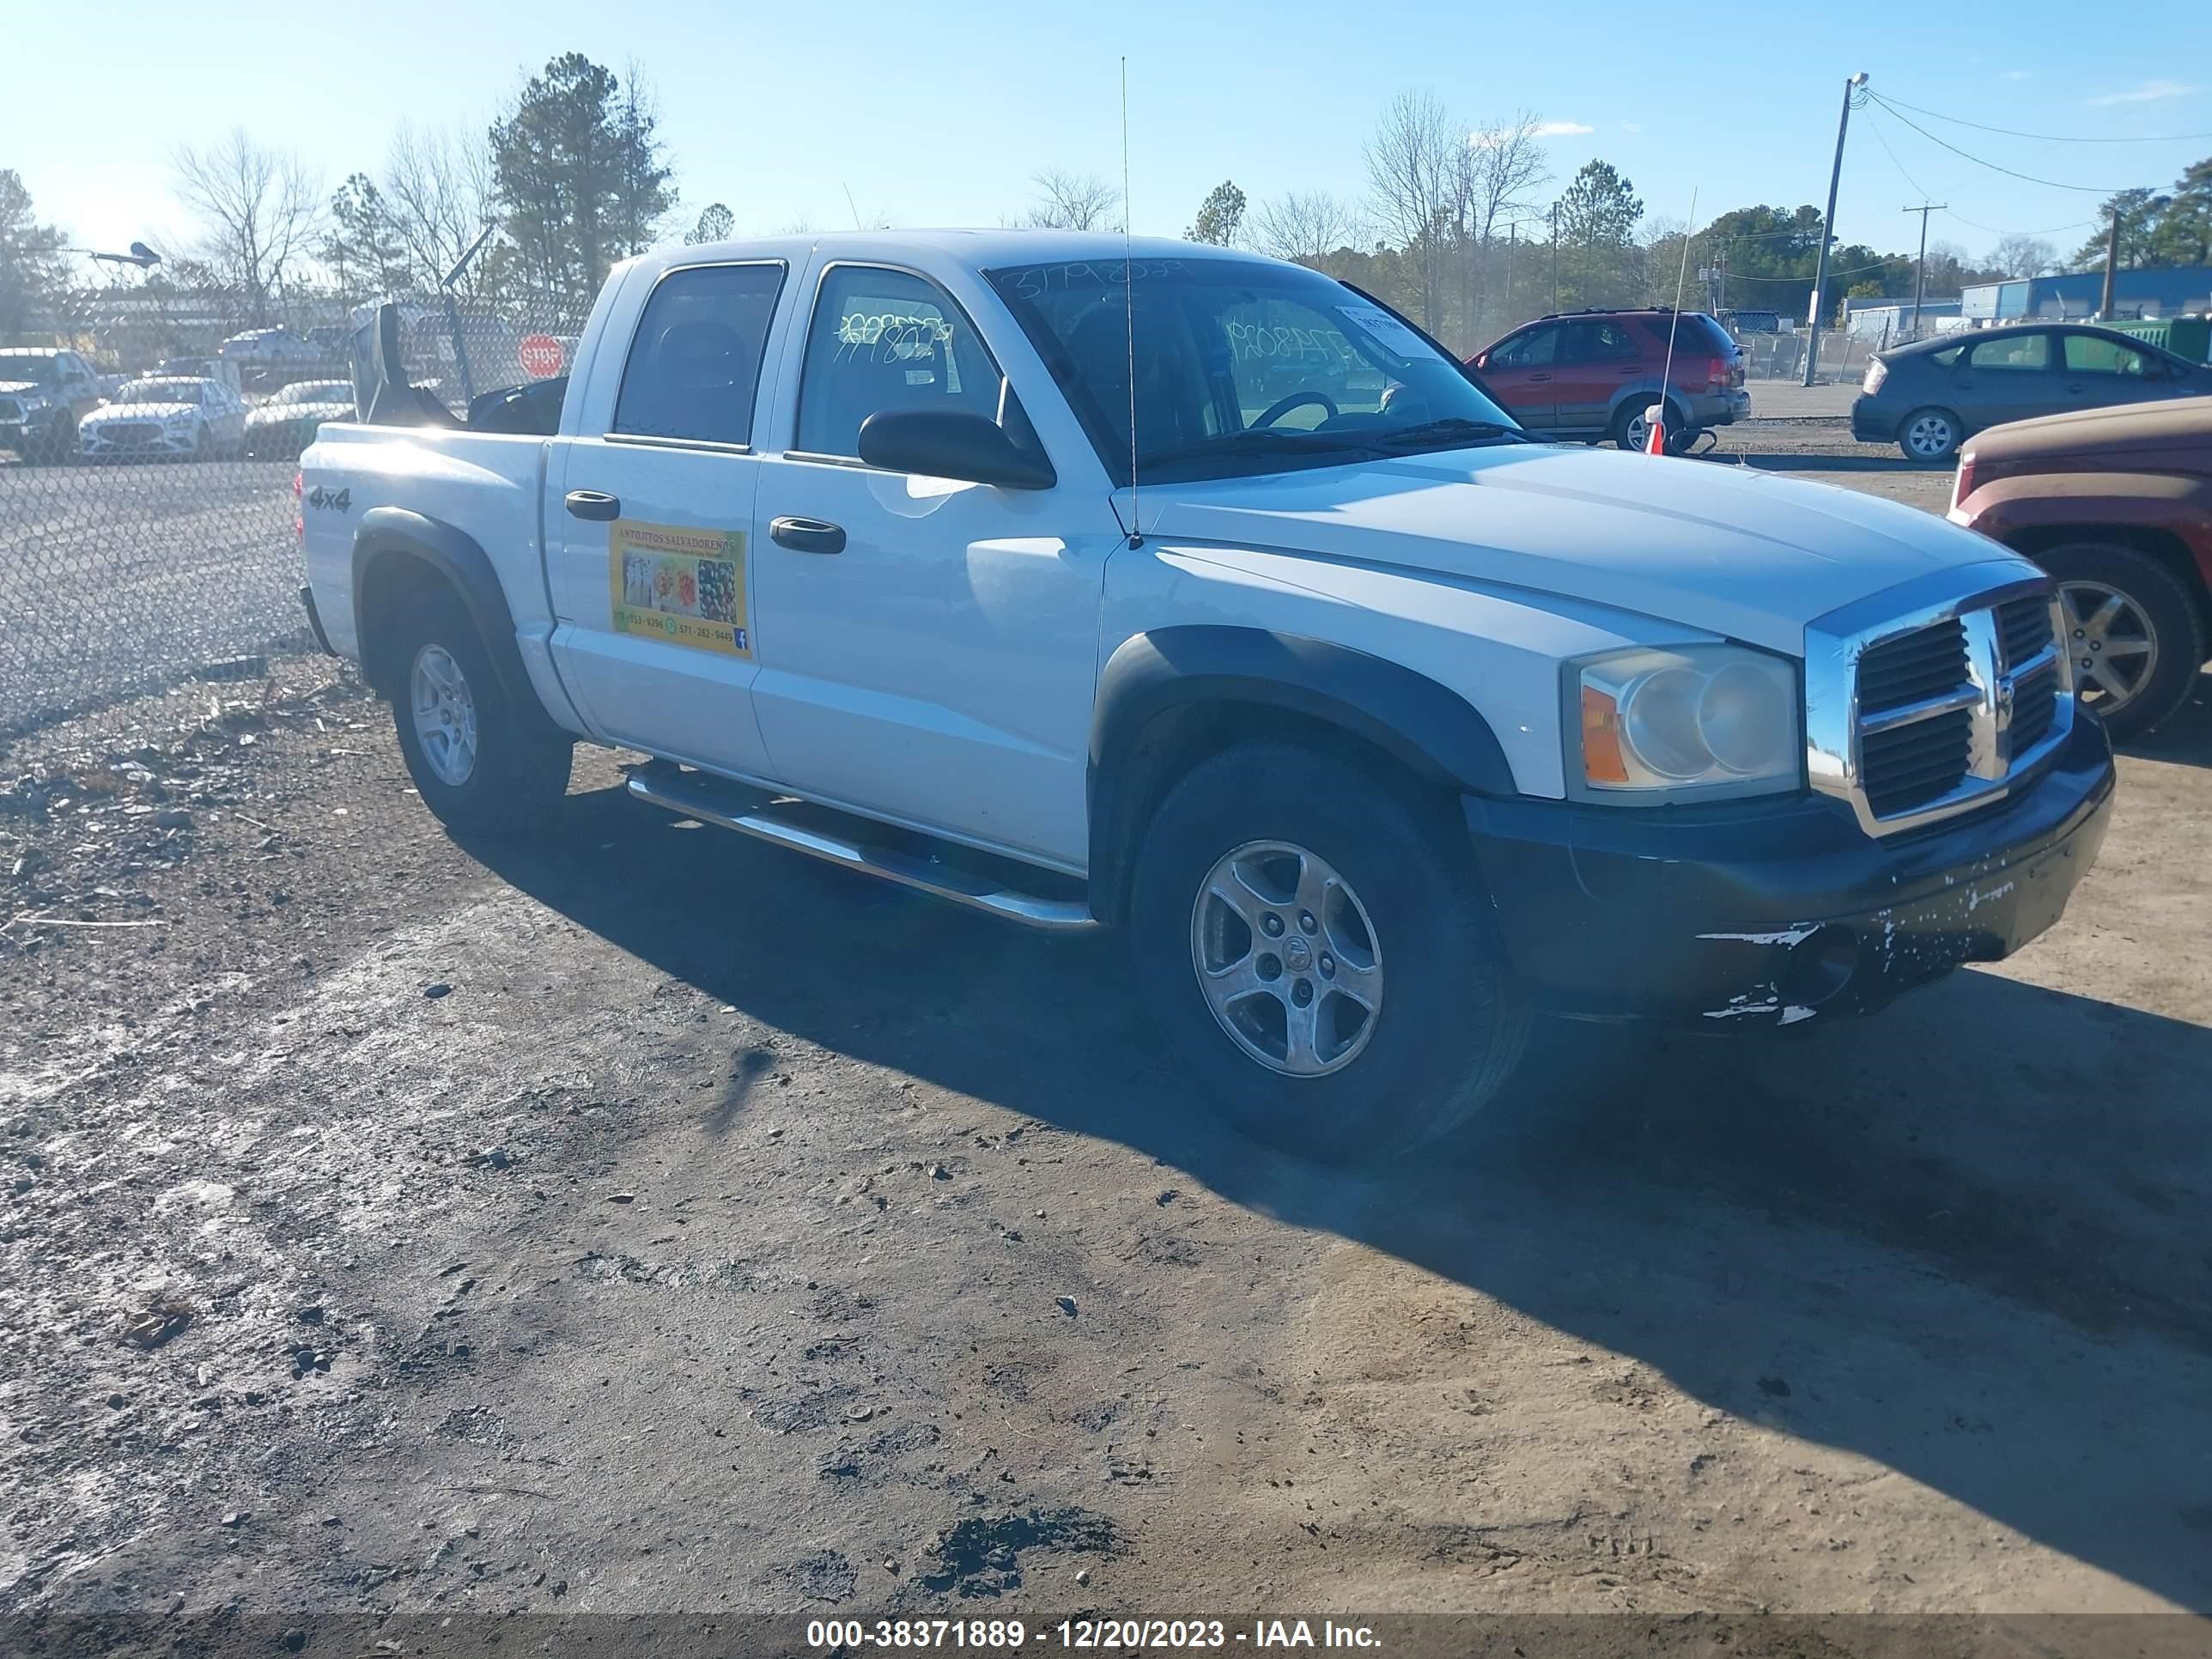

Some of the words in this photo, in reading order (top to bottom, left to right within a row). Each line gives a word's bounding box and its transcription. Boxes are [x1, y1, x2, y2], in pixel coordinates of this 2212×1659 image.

[522, 348, 560, 364] STOP
[309, 486, 353, 514] 4x4
[618, 528, 664, 543] ANTOJITOS
[665, 534, 735, 550] SALVADOREÑOS
